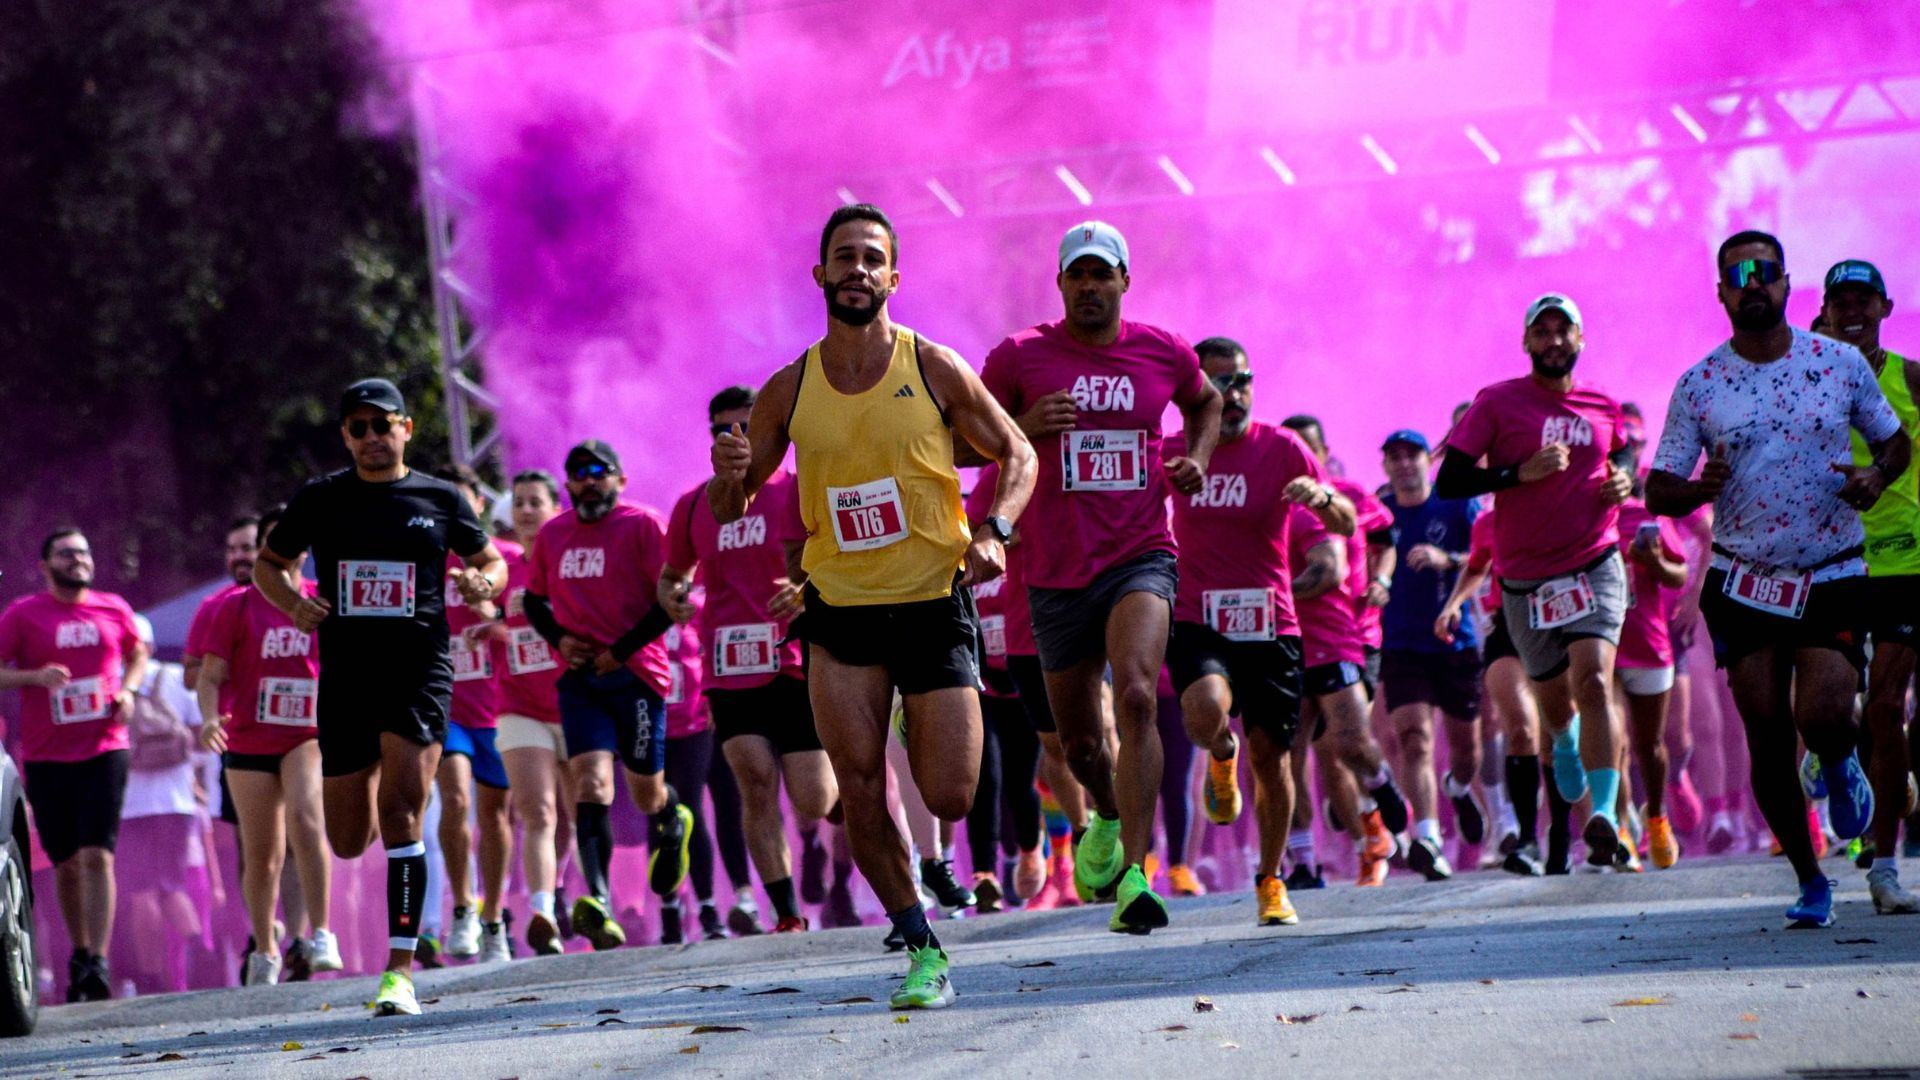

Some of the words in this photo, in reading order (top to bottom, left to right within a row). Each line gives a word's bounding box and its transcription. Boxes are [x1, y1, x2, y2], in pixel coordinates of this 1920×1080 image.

[881, 31, 1010, 89] Afya
[1071, 375, 1135, 393] AFYA
[1072, 390, 1135, 411] RUN
[1080, 441, 1105, 450] RUN
[1089, 452, 1122, 480] 281
[837, 497, 861, 508] RUN
[838, 490, 861, 500] AFYA
[407, 516, 435, 528] Afya
[849, 507, 885, 539] 176
[718, 528, 766, 552] RUN
[561, 548, 605, 564] AFYA
[356, 570, 378, 578] RUN
[559, 561, 605, 579] RUN
[360, 581, 393, 606] 242
[1750, 576, 1784, 605] 195
[1224, 609, 1257, 633] 288
[261, 638, 311, 659] RUN
[733, 642, 760, 666] 186
[633, 699, 651, 760] adidas
